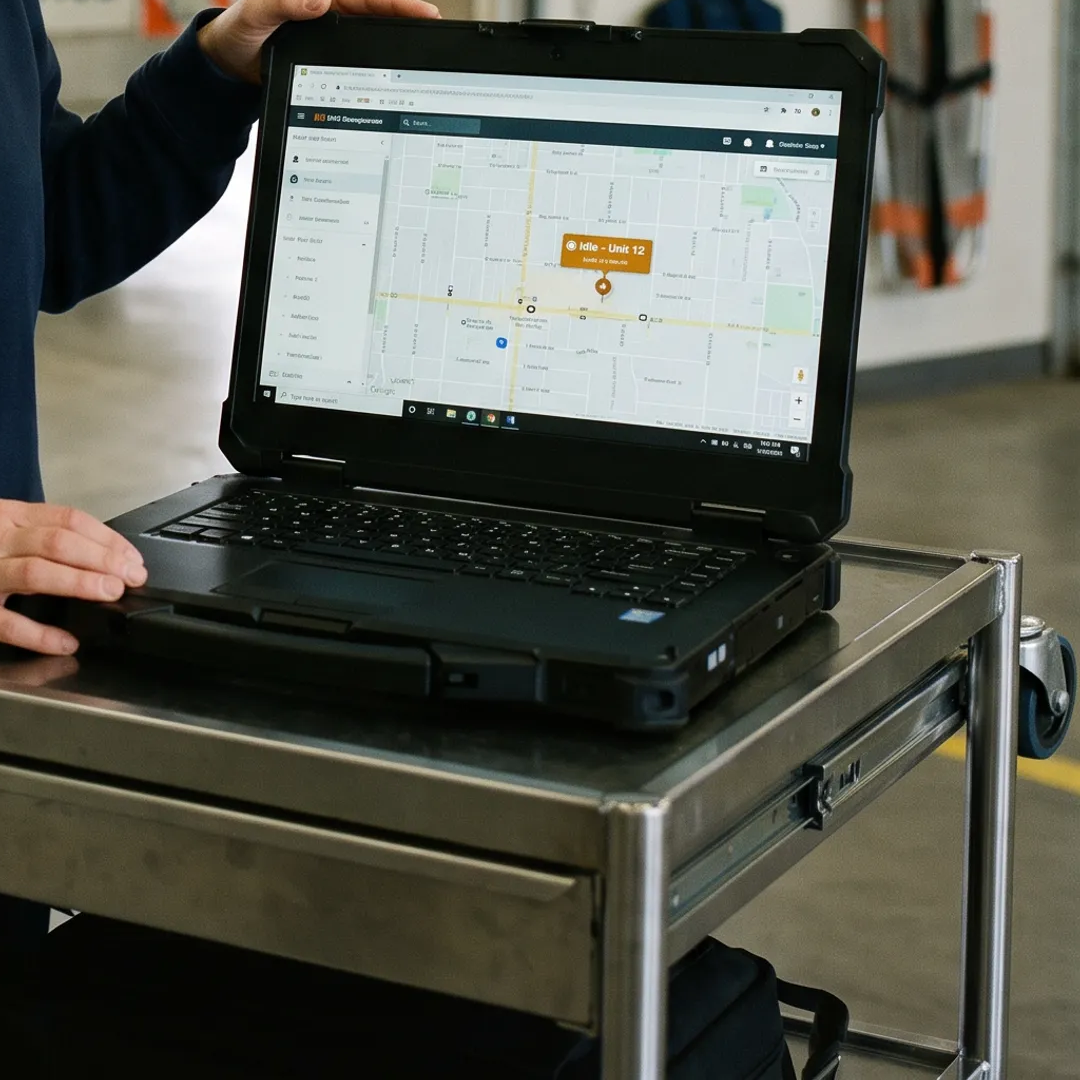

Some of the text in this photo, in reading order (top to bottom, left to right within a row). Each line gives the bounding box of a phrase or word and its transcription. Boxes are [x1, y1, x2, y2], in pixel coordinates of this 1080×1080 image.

[579, 242, 599, 252] Idle
[608, 243, 629, 254] Unit
[632, 245, 645, 256] 12
